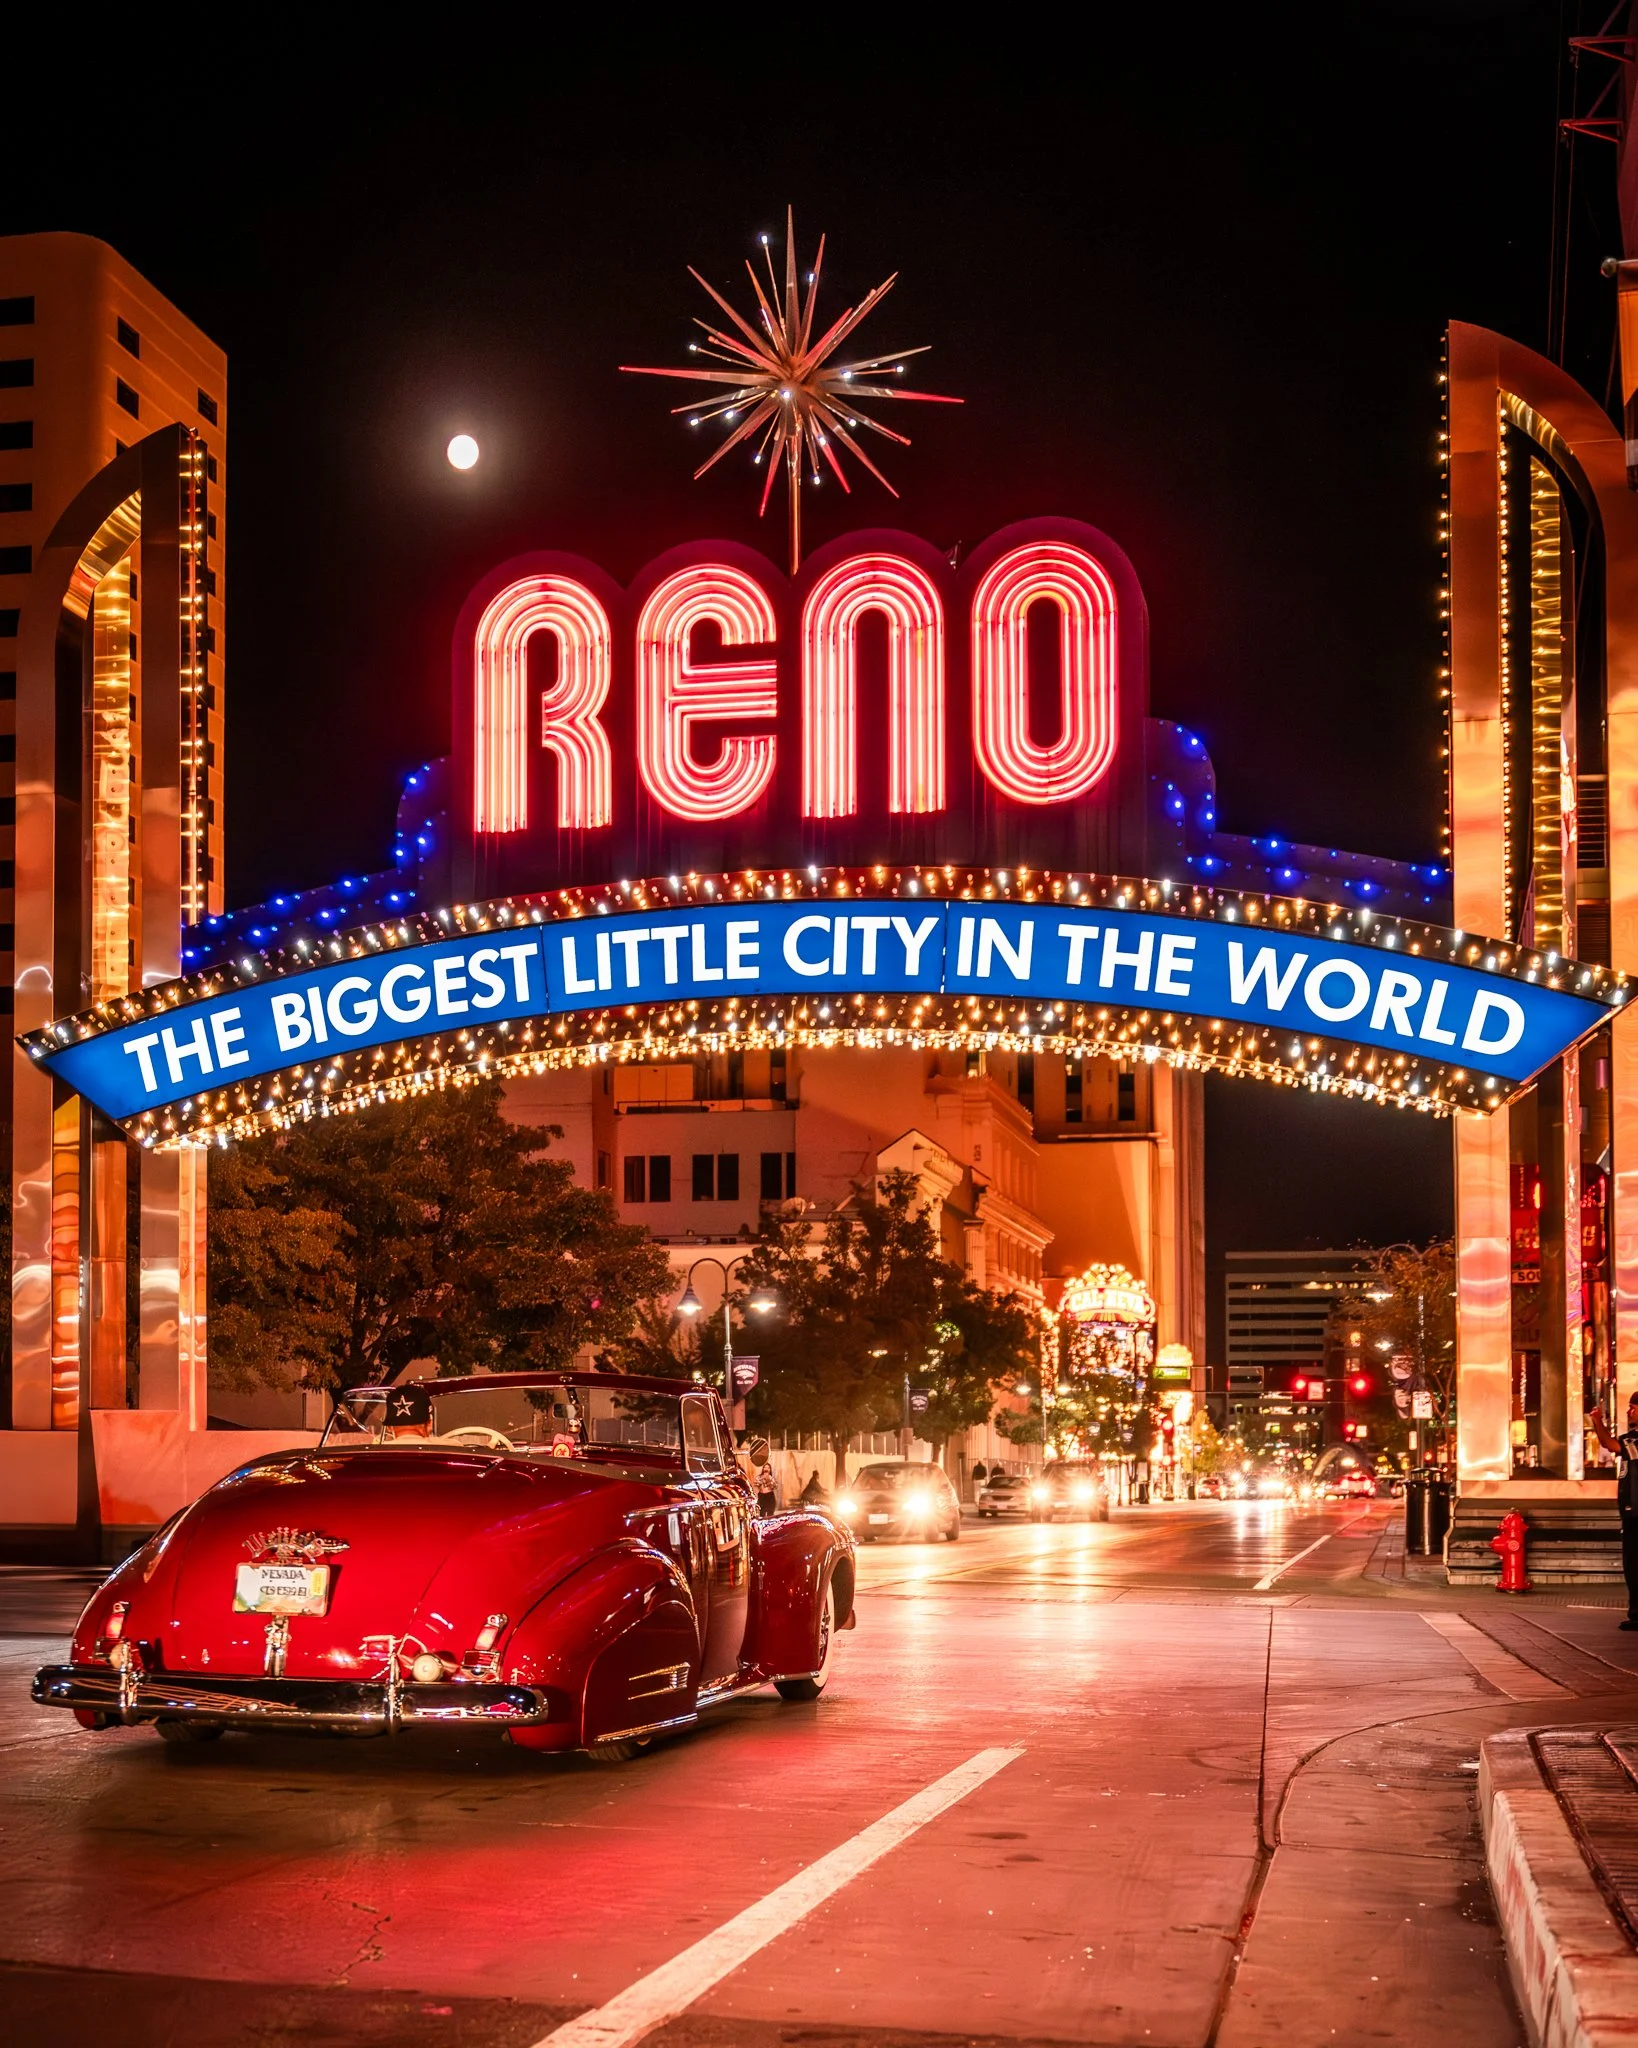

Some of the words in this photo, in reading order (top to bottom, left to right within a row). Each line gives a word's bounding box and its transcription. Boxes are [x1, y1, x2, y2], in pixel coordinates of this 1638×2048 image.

[473, 540, 1119, 834] RENO
[122, 1006, 251, 1094] THE
[270, 941, 539, 1053] BIGGEST
[561, 919, 761, 995] LITTLE
[782, 914, 941, 978] CITY
[955, 916, 1036, 981] IN
[1057, 922, 1198, 998] THE
[1227, 940, 1526, 1056] WORLD
[261, 1568, 306, 1580] NEVADA
